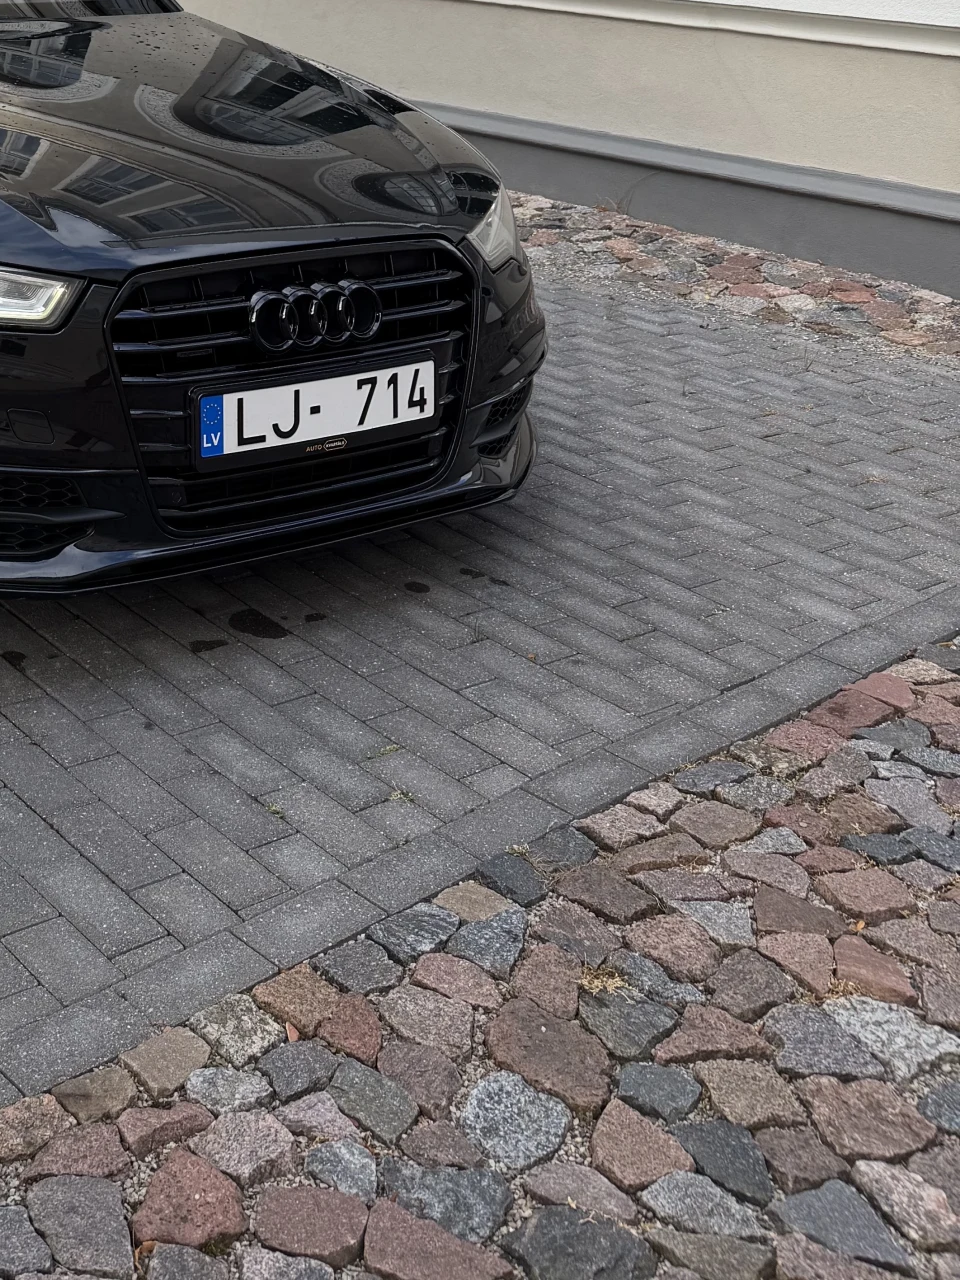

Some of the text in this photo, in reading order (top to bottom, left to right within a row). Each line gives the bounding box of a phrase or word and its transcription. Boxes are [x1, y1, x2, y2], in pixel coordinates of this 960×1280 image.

[237, 368, 427, 446] LJ- 714
[203, 432, 221, 448] LV
[306, 444, 323, 453] AUTO
